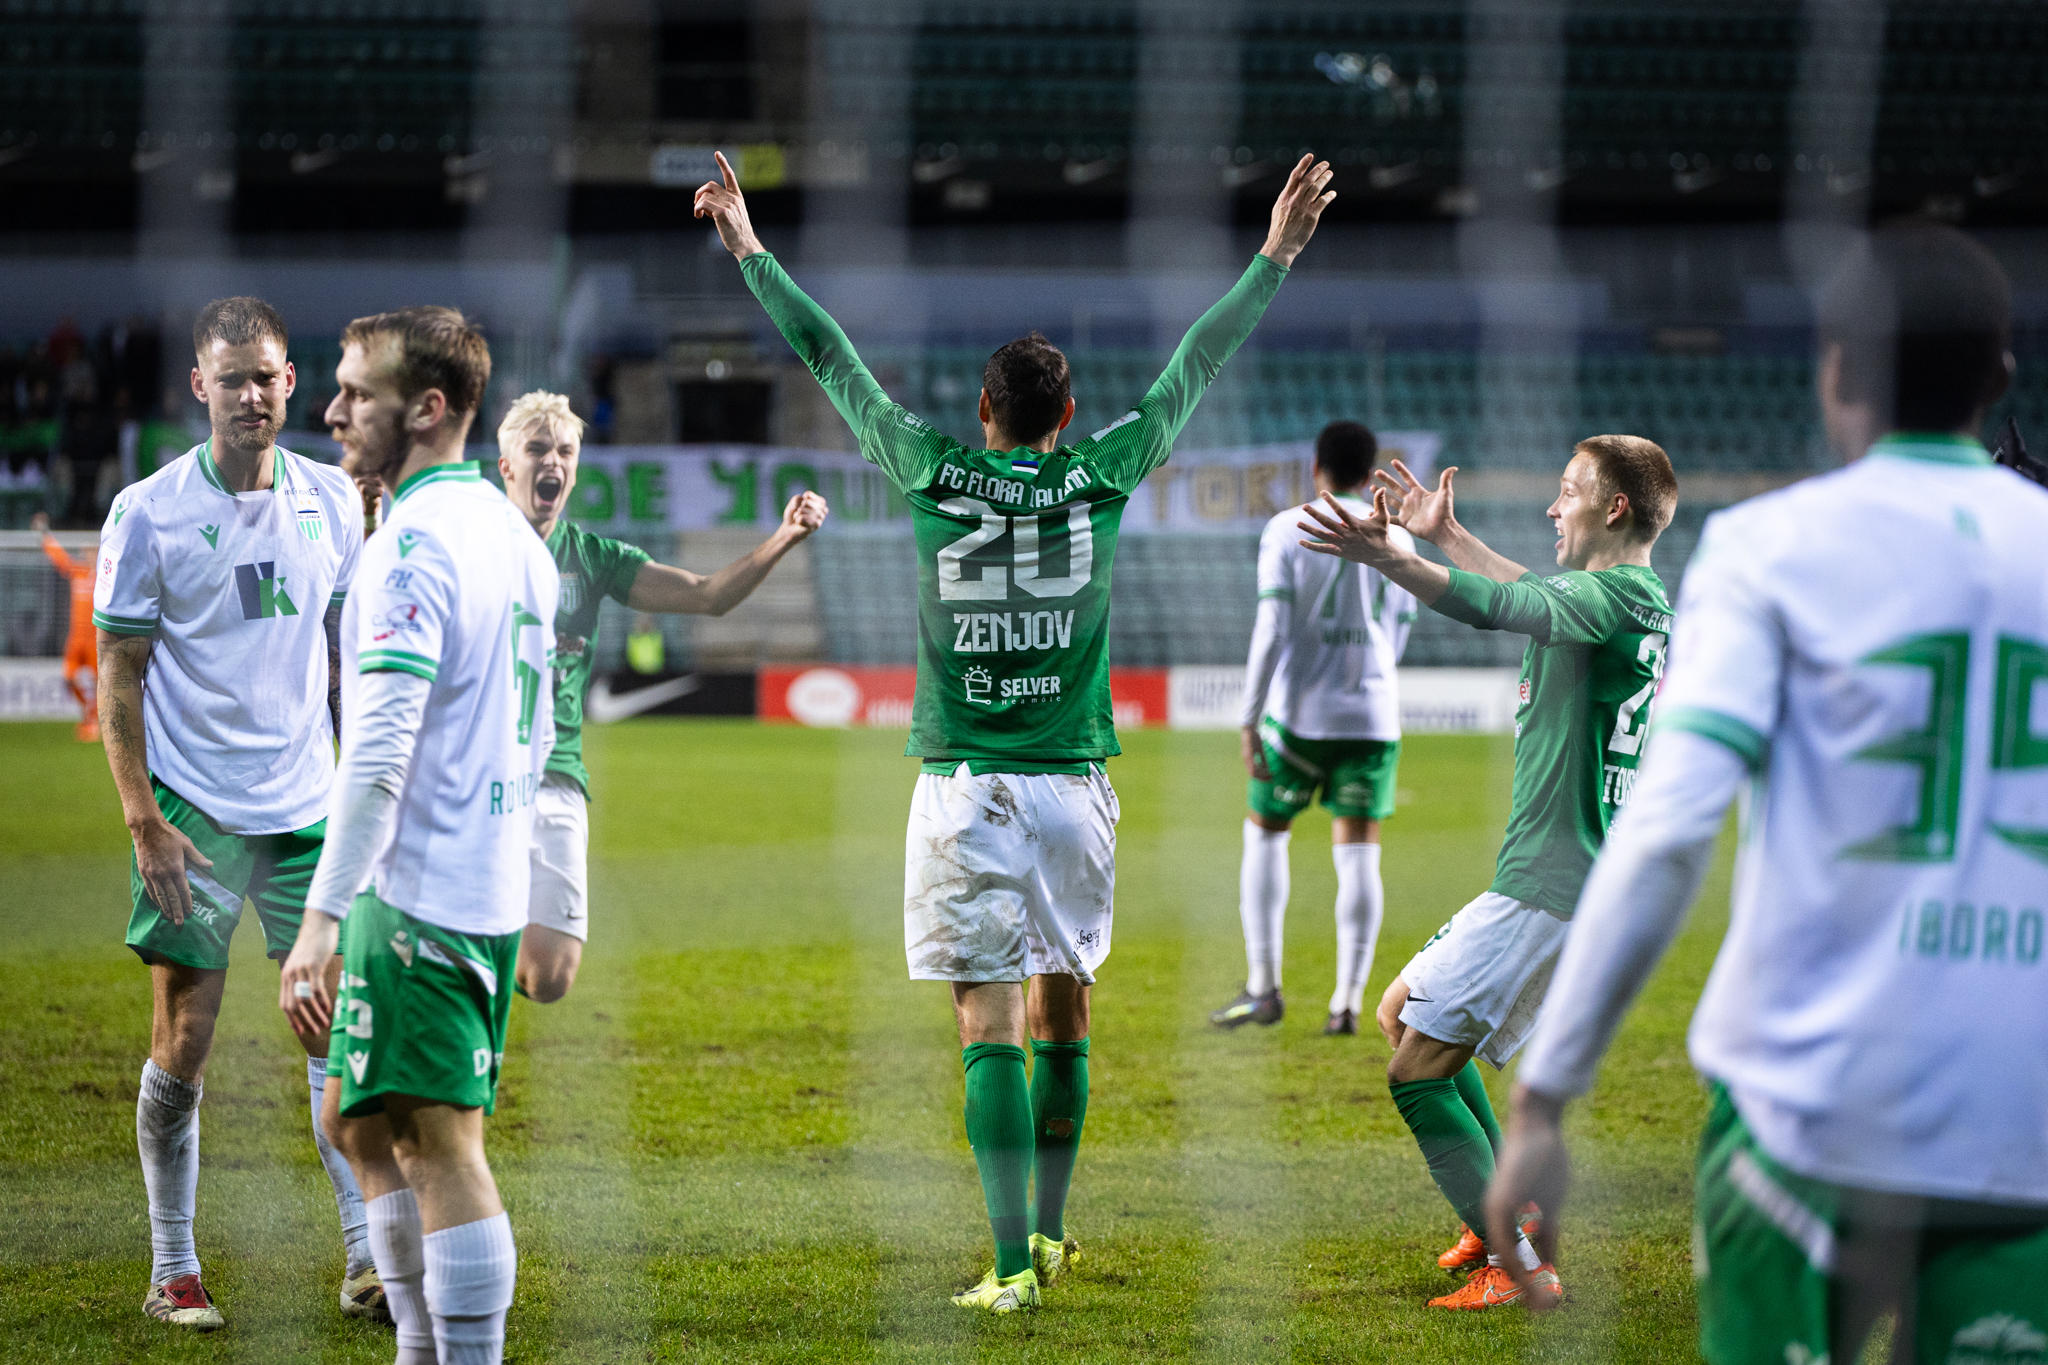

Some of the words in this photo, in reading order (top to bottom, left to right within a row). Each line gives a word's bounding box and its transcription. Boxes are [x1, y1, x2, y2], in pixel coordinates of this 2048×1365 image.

[938, 462, 965, 490] FC
[966, 470, 1025, 505] FLORA
[1029, 464, 1092, 508] TALLNN
[937, 496, 1093, 600] 20
[953, 609, 1075, 653] ZENJOV
[1000, 675, 1061, 698] SELVER
